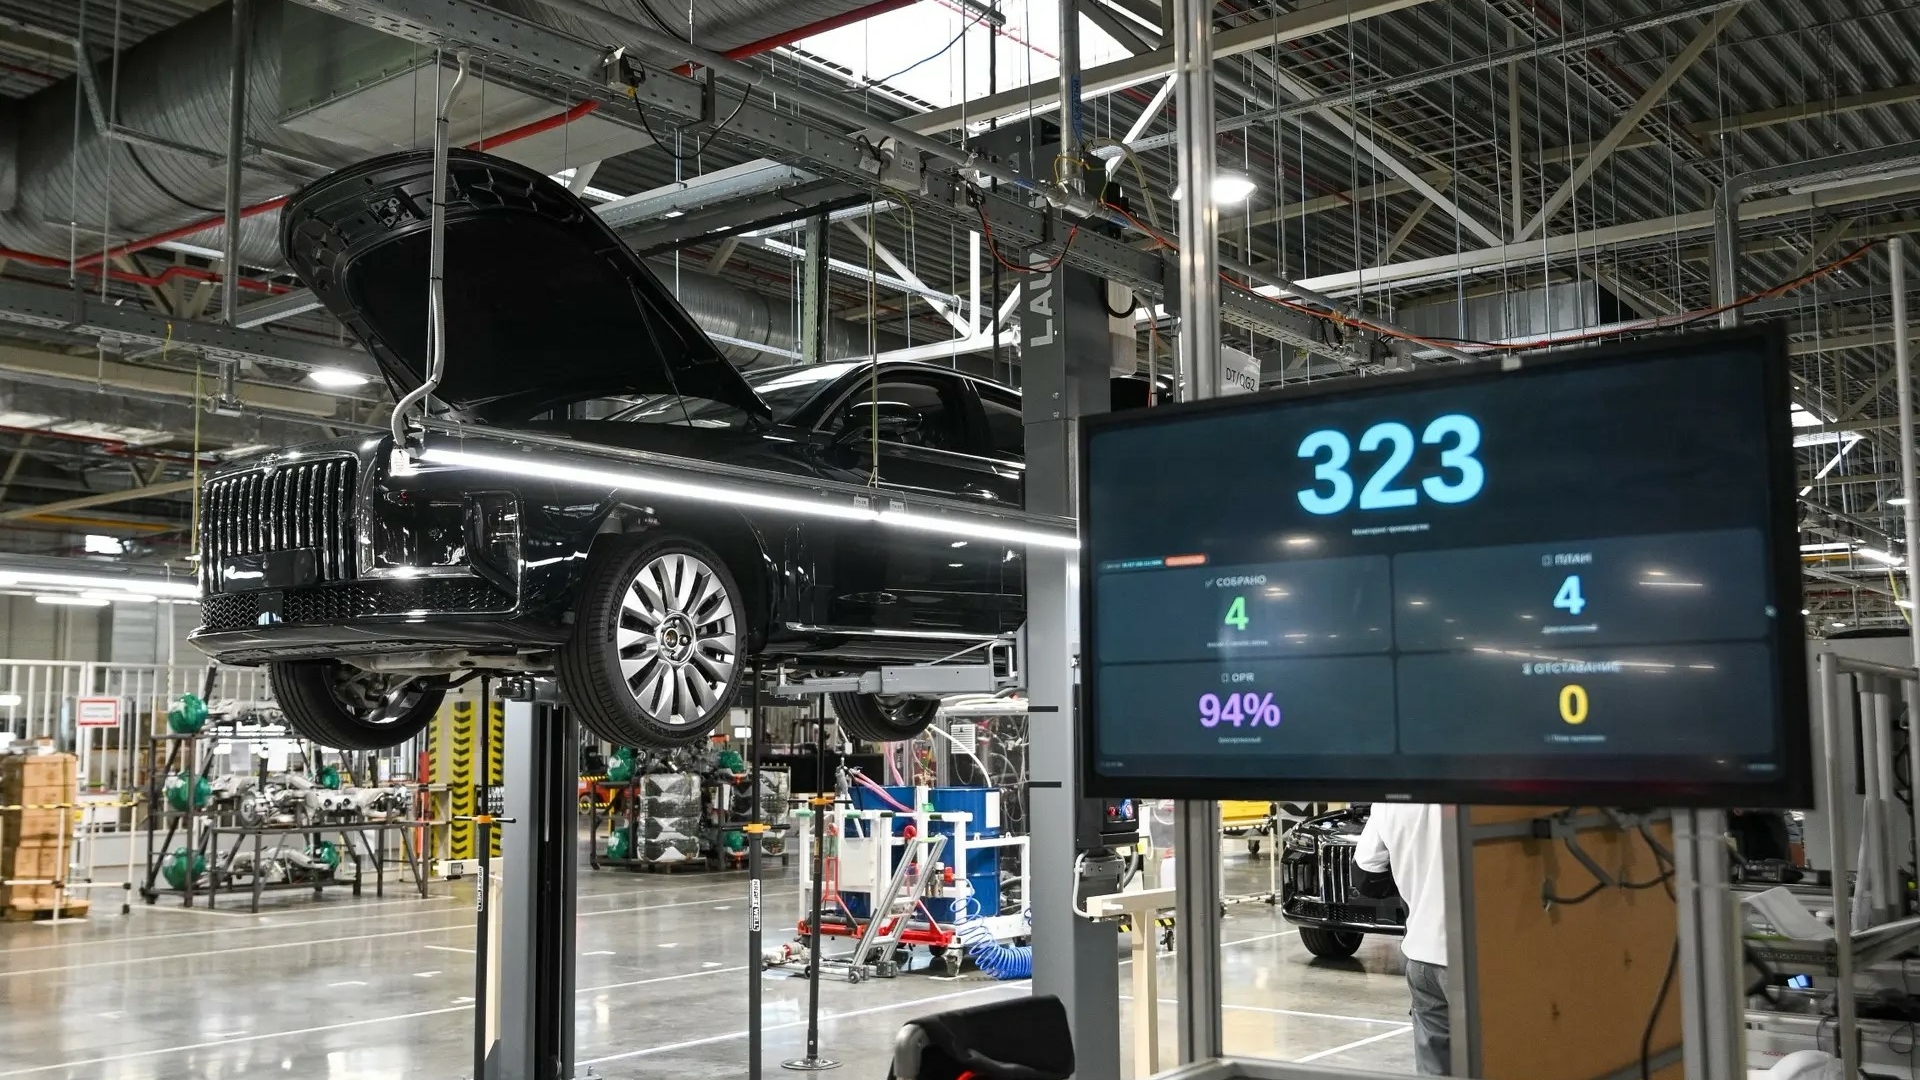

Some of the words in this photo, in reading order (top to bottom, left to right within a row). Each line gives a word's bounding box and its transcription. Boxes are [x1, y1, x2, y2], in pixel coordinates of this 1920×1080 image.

[1029, 252, 1053, 347] LAU
[1297, 414, 1484, 515] 323
[1216, 575, 1267, 588] СОБРАНО
[1553, 575, 1586, 614] 4
[1225, 597, 1249, 630] 4
[1199, 692, 1281, 727] 94%
[1559, 684, 1589, 724] 0
